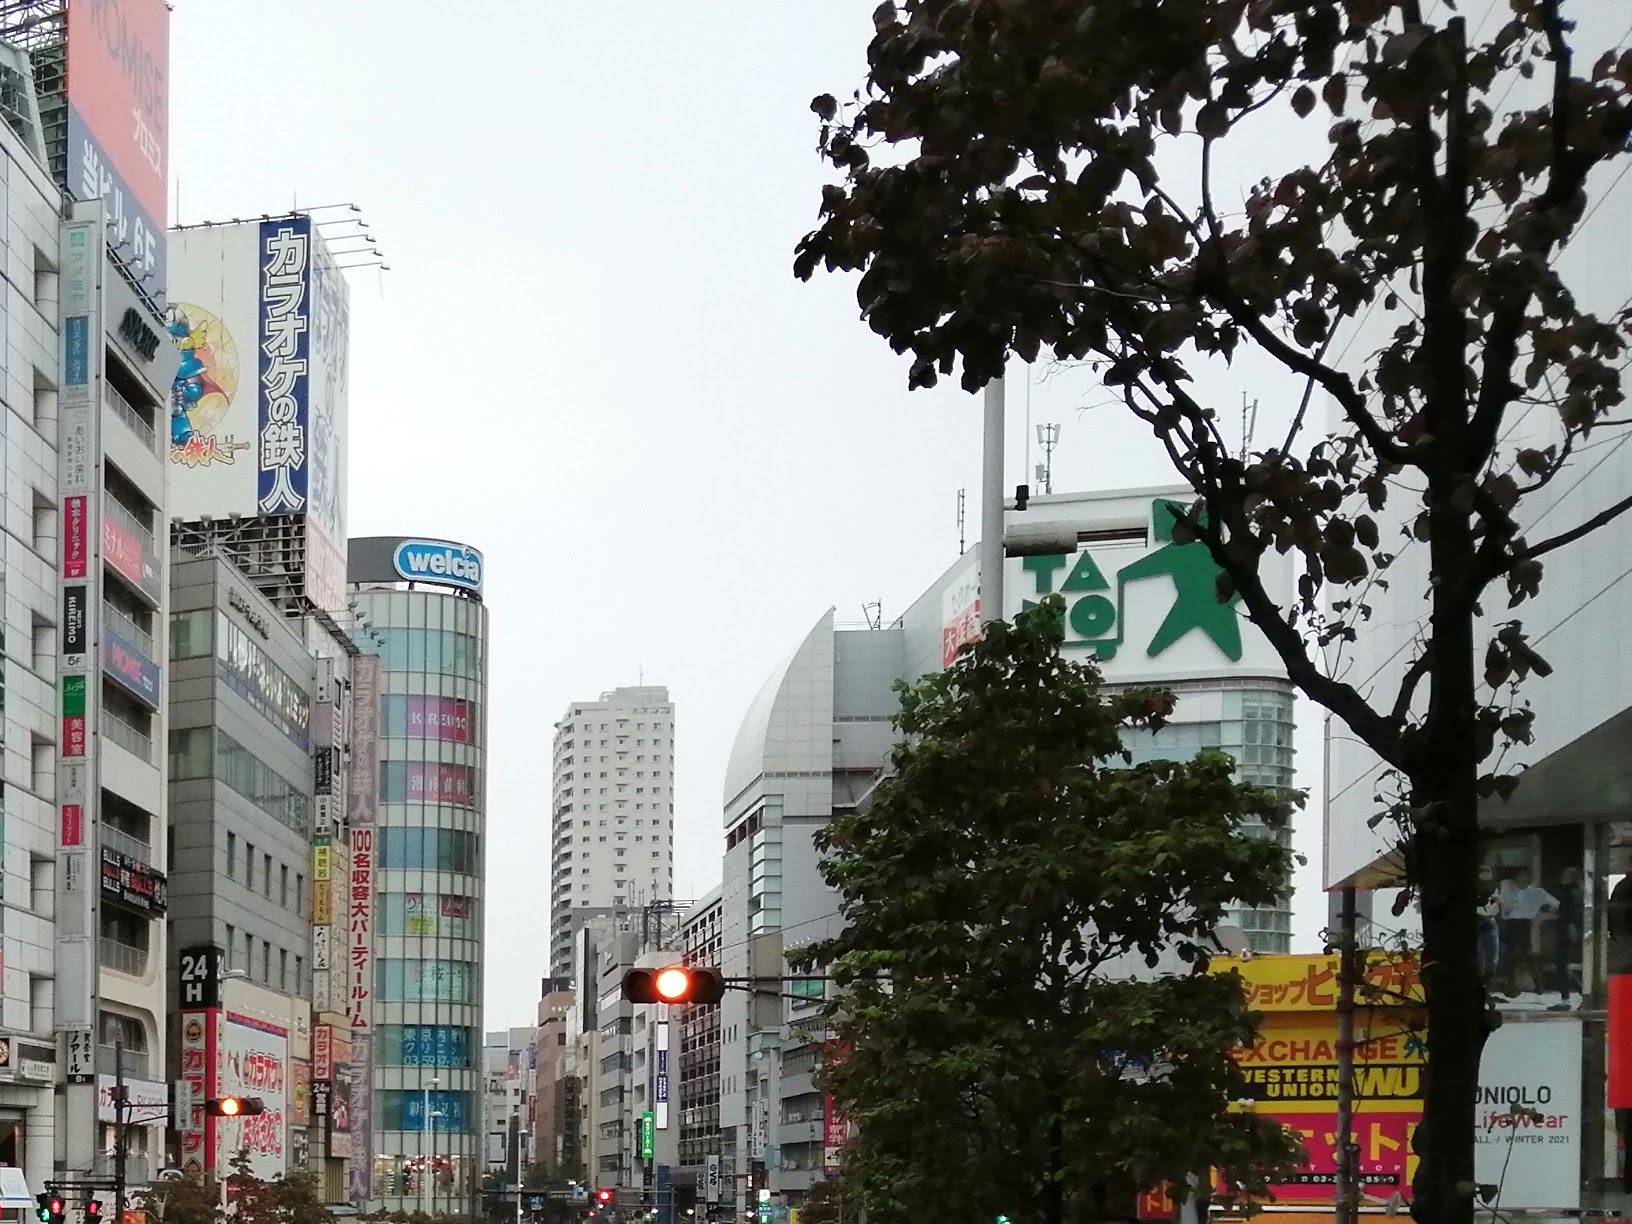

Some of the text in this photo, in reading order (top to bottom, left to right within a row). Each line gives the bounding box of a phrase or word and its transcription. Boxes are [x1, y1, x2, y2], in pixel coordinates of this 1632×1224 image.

[134, 216, 156, 272] 6F
[260, 228, 308, 513] カラオケの鉄人
[407, 549, 480, 583] welcia
[67, 596, 77, 644] KIREIMO
[68, 656, 81, 666] 5F
[103, 849, 120, 867] BULLS
[351, 829, 372, 1028] 100名収容大パーティールーム
[181, 954, 208, 981] 24
[186, 983, 202, 1002] H
[317, 1029, 329, 1077] カラオケ
[1230, 1038, 1399, 1061] EXCHAGE
[1267, 1083, 1338, 1097] UNION
[1474, 1111, 1569, 1129] LifeWear
[1505, 1135, 1543, 1144] WINTER
[1548, 1135, 1570, 1144] 2021
